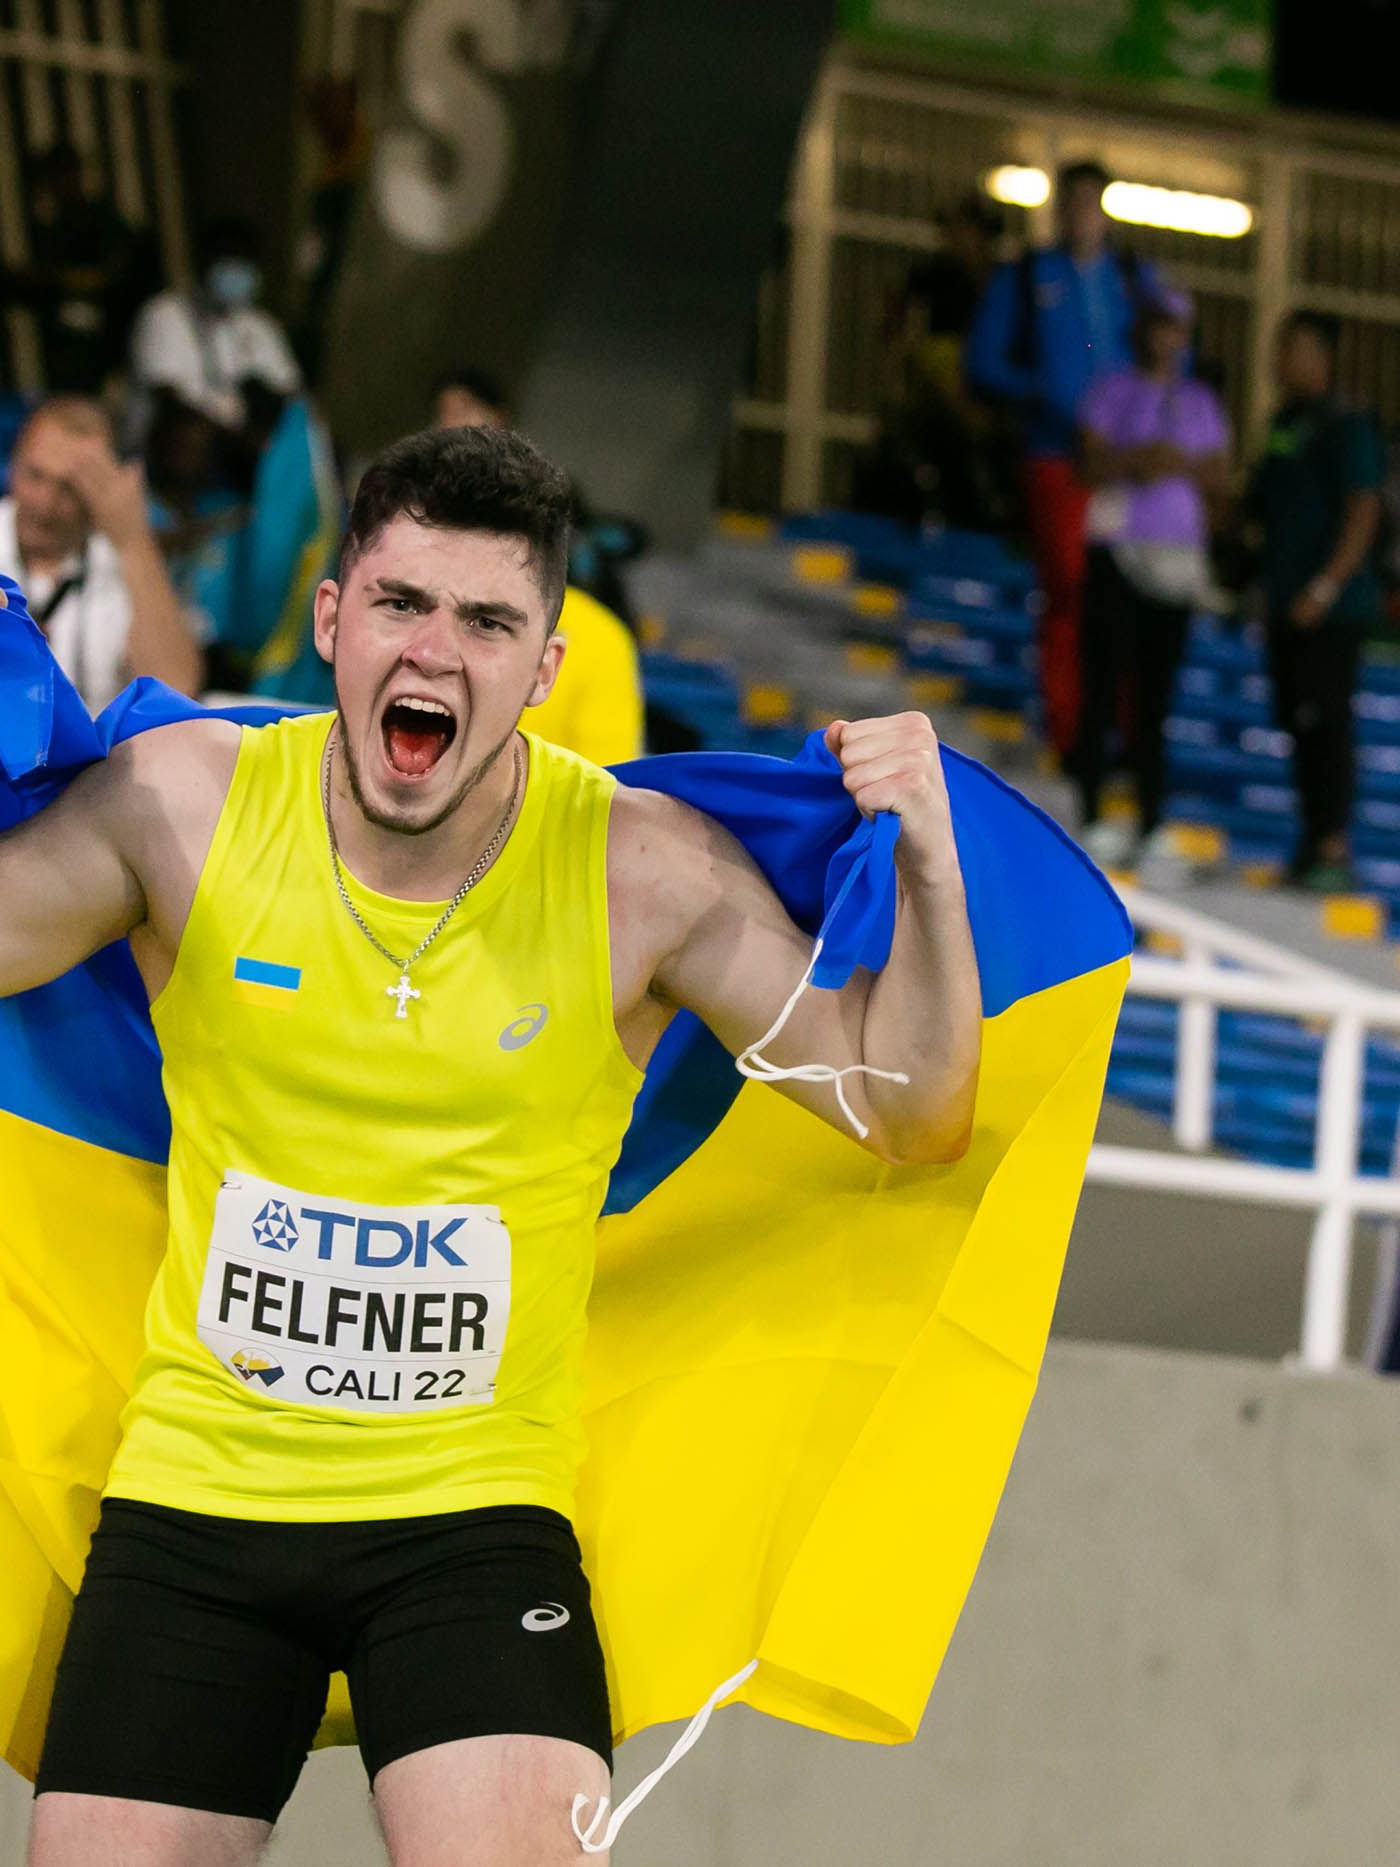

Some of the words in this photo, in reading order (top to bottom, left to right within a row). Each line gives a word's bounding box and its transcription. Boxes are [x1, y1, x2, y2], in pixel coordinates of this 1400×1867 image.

[299, 1207, 469, 1268] TDK
[218, 1261, 489, 1353] FELFNER
[305, 1364, 401, 1401] CALI
[413, 1369, 466, 1401] 22
